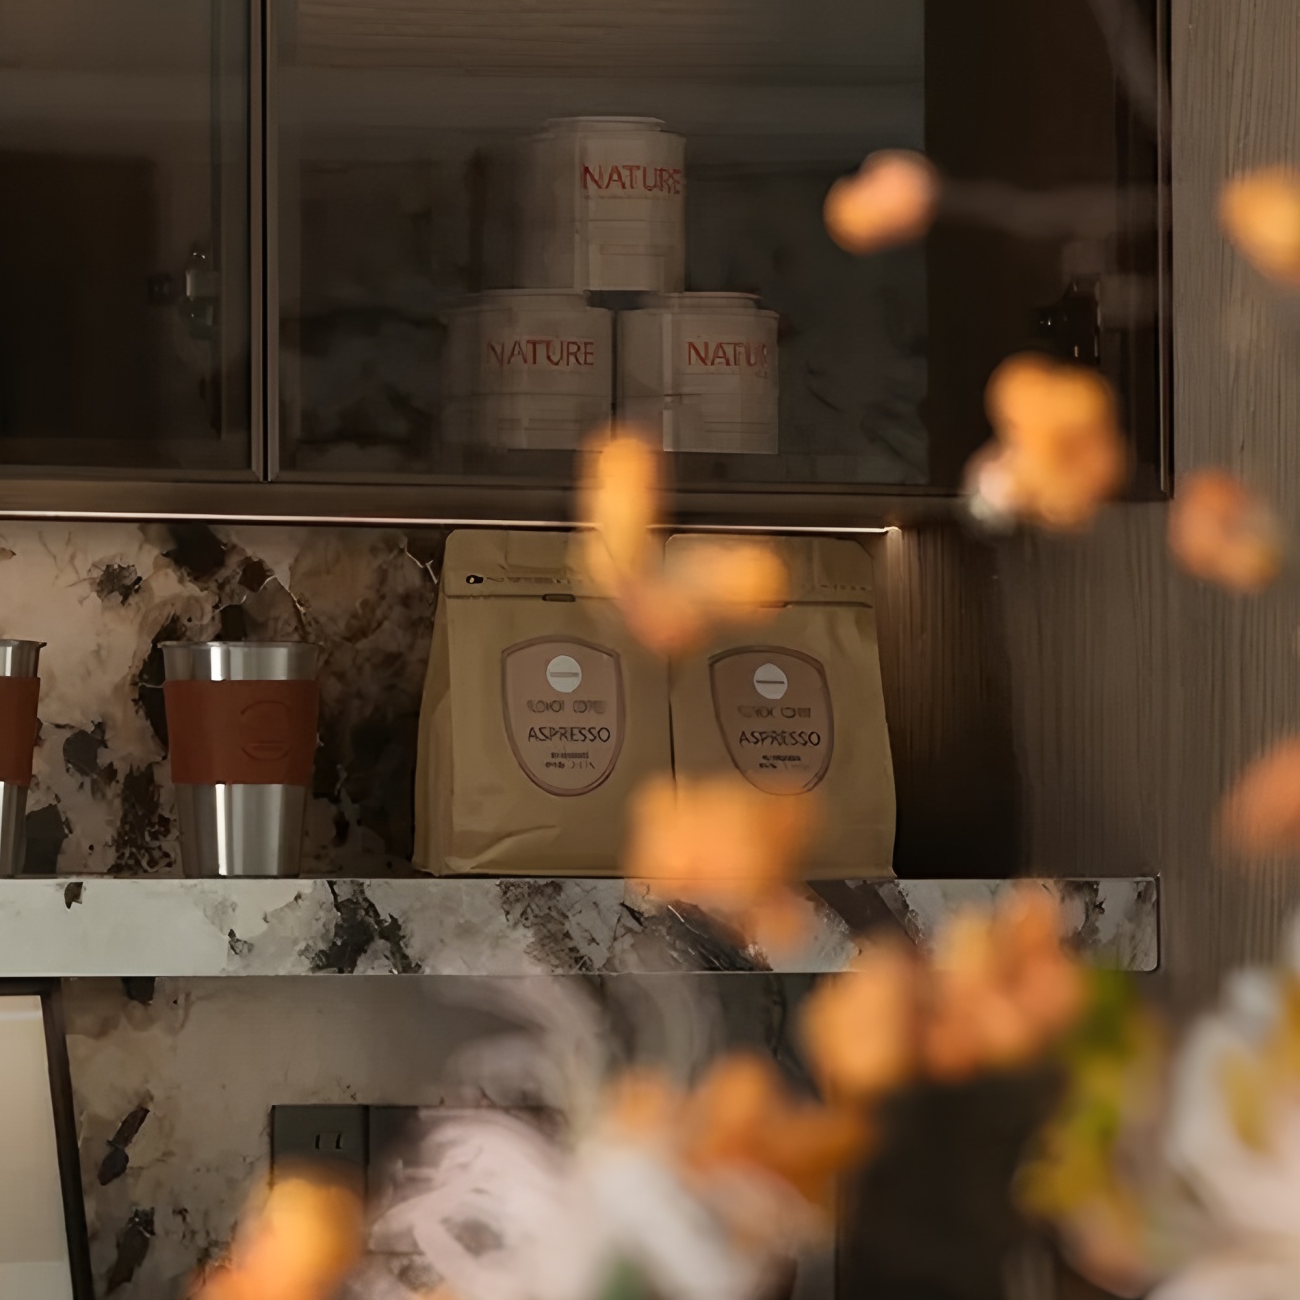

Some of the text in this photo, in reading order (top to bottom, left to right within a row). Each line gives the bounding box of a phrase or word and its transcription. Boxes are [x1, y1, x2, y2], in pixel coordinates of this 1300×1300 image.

[583, 165, 682, 194] NATURE
[486, 340, 594, 366] NATURE
[528, 726, 611, 743] ASPRESSO
